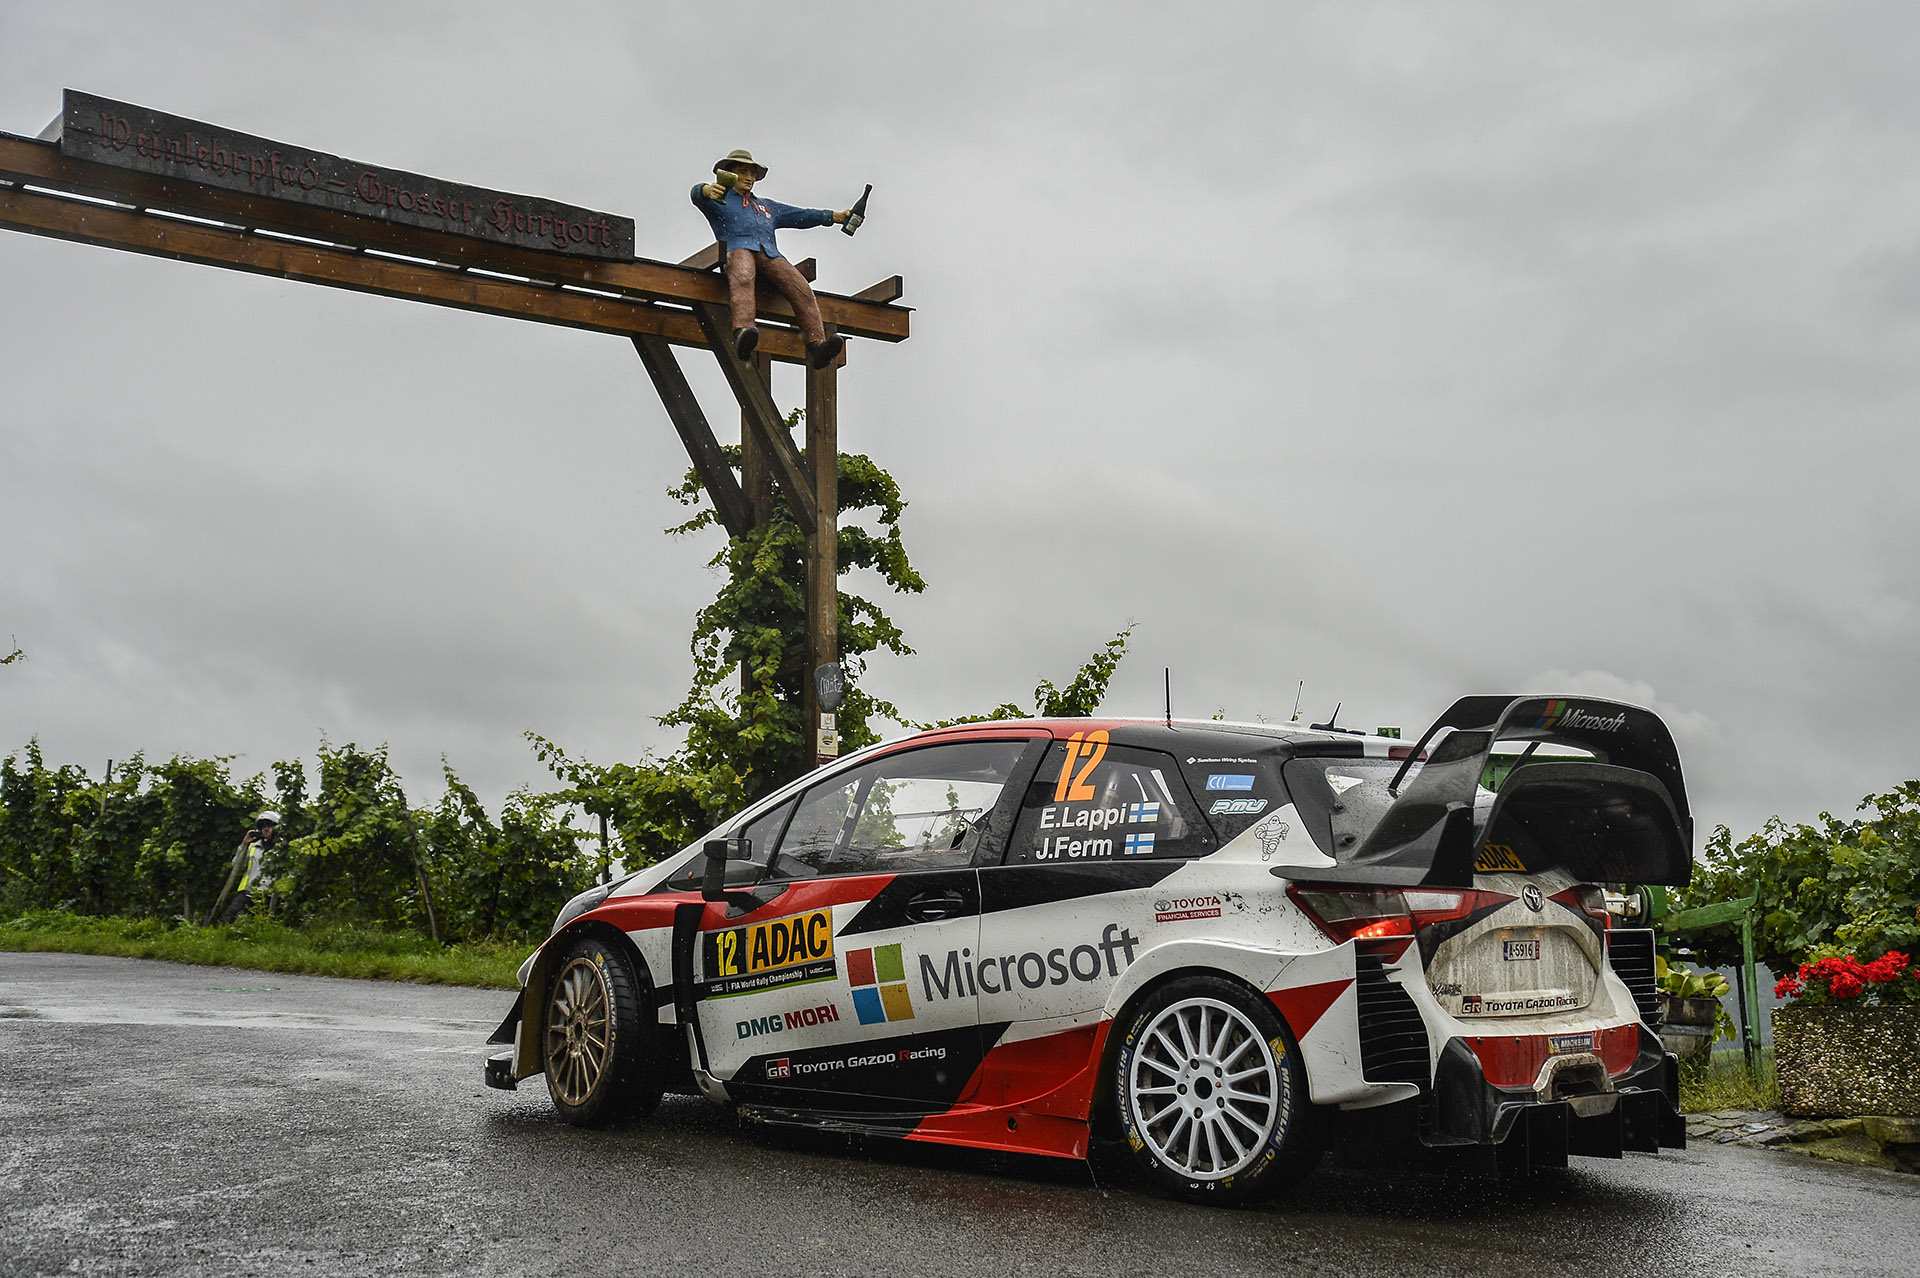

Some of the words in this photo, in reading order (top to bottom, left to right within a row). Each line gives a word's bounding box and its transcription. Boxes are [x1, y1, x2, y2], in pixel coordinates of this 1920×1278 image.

[100, 113, 319, 191] Weinlehrpfad
[357, 170, 475, 222] Grosser
[487, 198, 613, 249] Herrgott
[1556, 709, 1627, 732] Microsoft
[1053, 730, 1110, 802] 12
[1039, 802, 1127, 831] E.Lappi
[1036, 836, 1113, 860] J.Ferm
[1475, 846, 1520, 869] ADAC
[1157, 912, 1190, 921] FINANCIAL
[1189, 909, 1219, 918] SERVICES
[1172, 896, 1221, 909] TOYOTA
[716, 930, 738, 977] 12
[751, 912, 828, 970] ADAC
[919, 923, 1139, 1002] Microsoft
[731, 982, 741, 991] FIA
[740, 980, 756, 989] World
[756, 977, 769, 987] Rally
[769, 970, 803, 984] Championship
[602, 968, 617, 1027] MICHELIN
[1462, 1002, 1481, 1014] GR
[1485, 1001, 1524, 1012] TOYOTA
[1525, 998, 1555, 1009] GAZOO
[1556, 996, 1578, 1008] Racing
[736, 1014, 783, 1039] DMG
[783, 1004, 840, 1030] MORI
[767, 1064, 790, 1078] GR
[793, 1060, 845, 1074] TOYOTA
[847, 1053, 896, 1067] GAZOO
[899, 1047, 946, 1060] Racing
[1118, 1049, 1130, 1124] MICHELIN
[1275, 1067, 1291, 1145] MICHELIN
